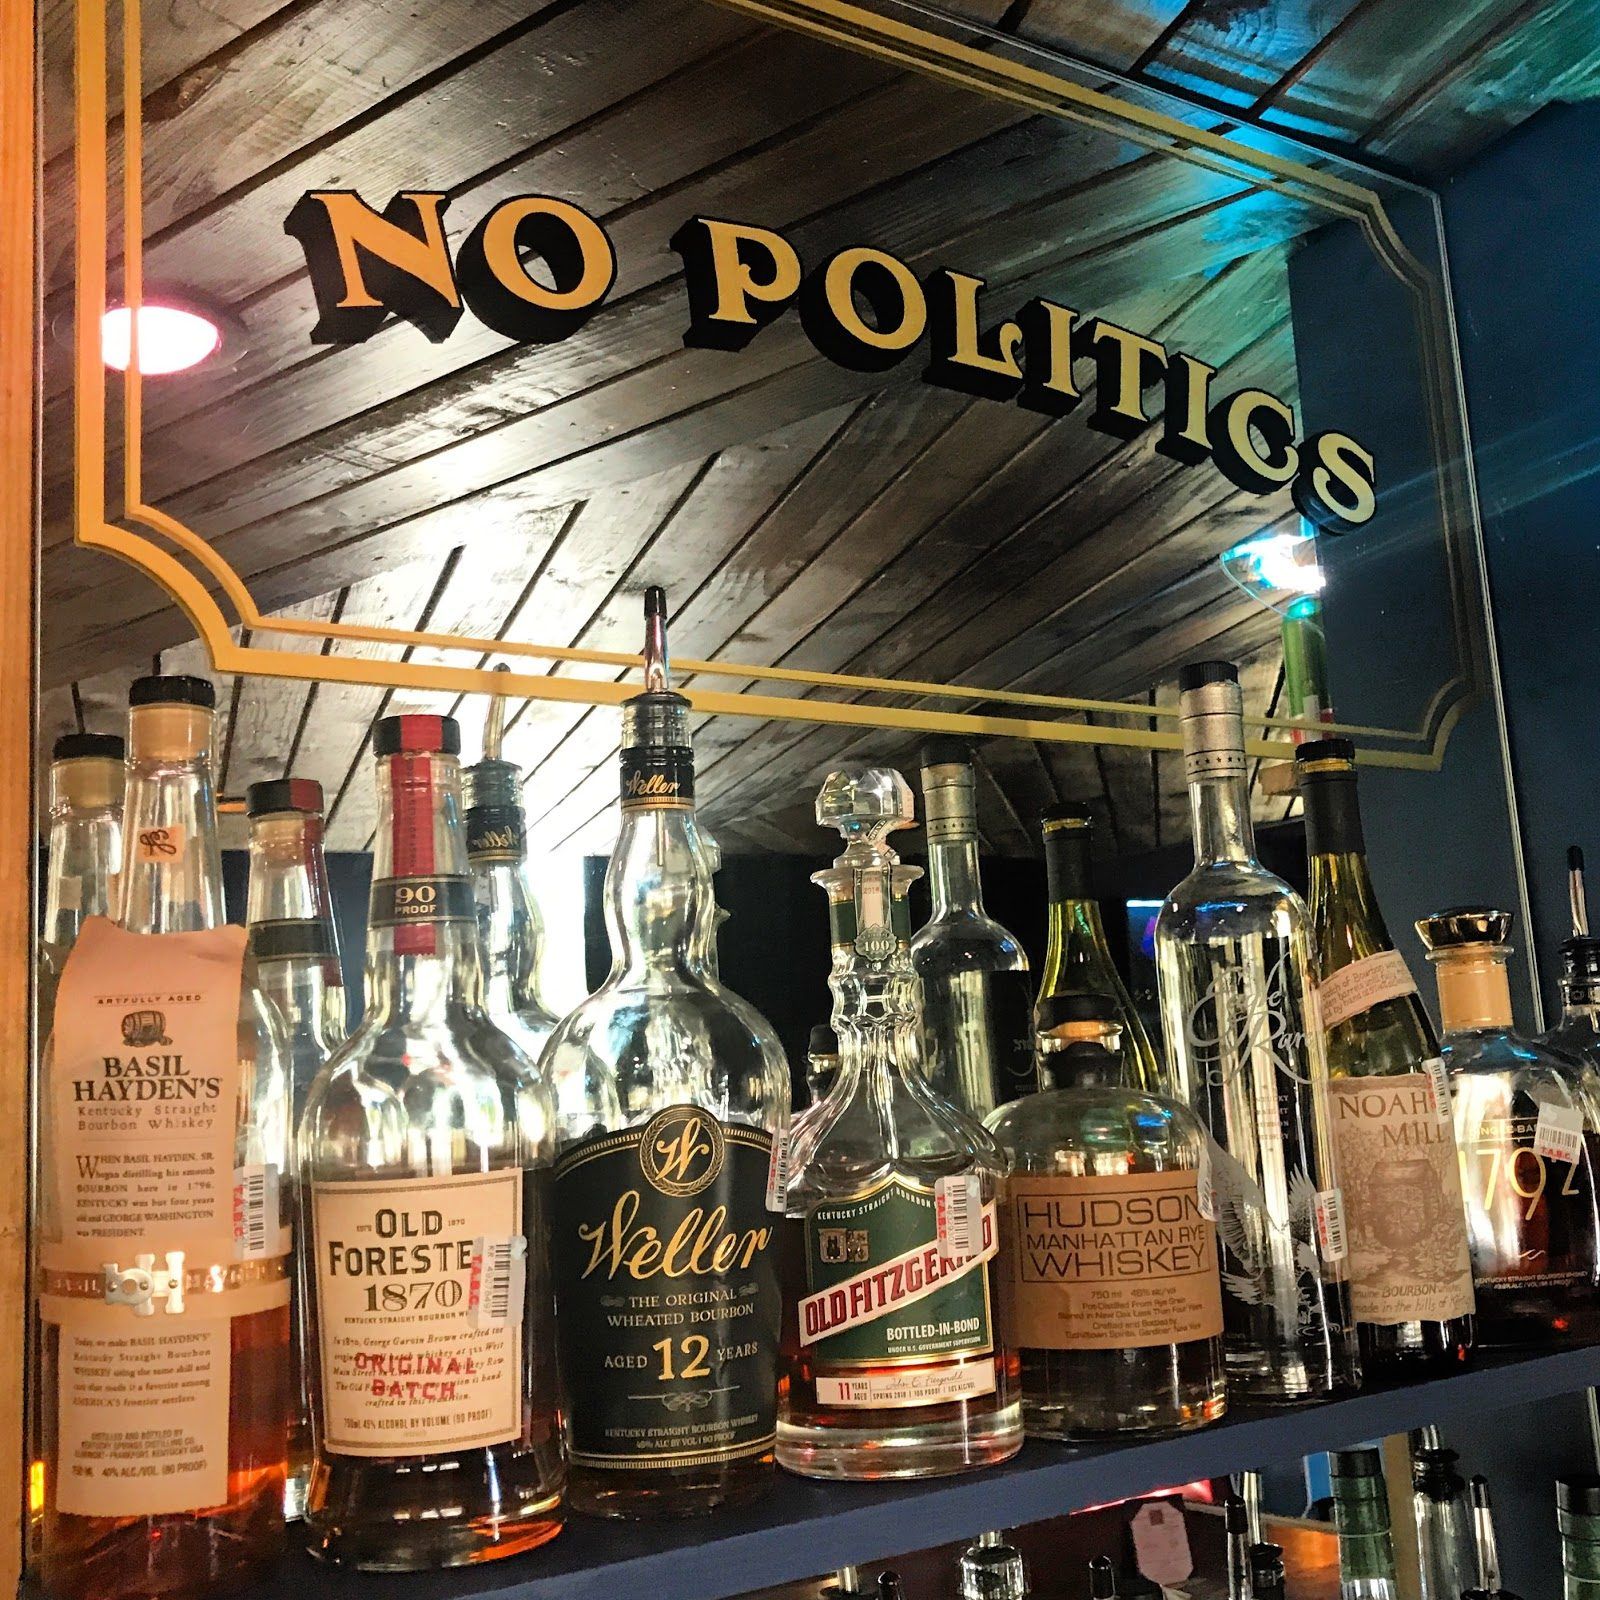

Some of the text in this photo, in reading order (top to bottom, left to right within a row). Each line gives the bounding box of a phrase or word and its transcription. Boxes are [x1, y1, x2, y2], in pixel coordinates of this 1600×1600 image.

[284, 190, 1379, 534] NO POLITICS
[626, 770, 680, 795] Weller
[394, 885, 436, 904] 90
[394, 904, 437, 914] PROOF
[864, 940, 890, 952] 100
[97, 994, 202, 1005] ARTFULLY AGED
[102, 1055, 190, 1078] BASIL
[72, 1077, 220, 1101] HAYDEN'S
[78, 1102, 216, 1117] Kentucky Straight
[78, 1117, 213, 1131] Bourbon Whiskey
[1382, 1121, 1449, 1147] MILL
[123, 1155, 149, 1164] BASIL
[1540, 1146, 1573, 1162] T.A.B.C.
[76, 1184, 128, 1193] BOURBON
[817, 1186, 932, 1220] KENTUCKY STRAIGHT BOURBON
[1024, 1195, 1203, 1228] HUDSON
[102, 1211, 214, 1223] GEORGE WASHINGTON
[375, 1208, 443, 1239] OLD
[937, 1194, 947, 1242] T.A.B.C.
[578, 1190, 774, 1281] Weller
[1026, 1224, 1205, 1250] MANHATTAN RYE
[328, 1240, 474, 1277] FORESTE
[1029, 1242, 1205, 1277] WHISKEY
[469, 1254, 482, 1310] T.A.B.C.
[1381, 1284, 1437, 1298] BOURBON
[364, 1279, 463, 1313] 1870
[628, 1288, 738, 1308] THE ORIGINAL
[344, 1316, 378, 1325] KENTUCKY
[378, 1315, 415, 1324] STRAIGHT
[418, 1313, 456, 1322] BOURBON
[607, 1302, 754, 1327] WHEATED BOURBON
[805, 1289, 848, 1337] OLD
[364, 1338, 391, 1349] George
[427, 1334, 456, 1343] Brown
[459, 1330, 490, 1340] crafted
[887, 1317, 980, 1341] BOTTLED-IN-BOND
[486, 1342, 504, 1351] West
[888, 1346, 906, 1354] UNDER
[918, 1340, 953, 1351] GOVERNMENT
[953, 1335, 981, 1346] SUPERVISION
[354, 1352, 477, 1375] ORIGINAL
[604, 1334, 758, 1380] AGED 12 YEARS
[372, 1378, 456, 1400] BATCH
[838, 1382, 868, 1401] 11 YEARS
[854, 1392, 867, 1401] AGED
[873, 1392, 893, 1400] SPRING
[378, 1418, 408, 1430] ALCOHOL
[410, 1418, 419, 1427] BY
[422, 1415, 450, 1427] VOLUME
[468, 1408, 492, 1422] PROOF)
[604, 1428, 647, 1438] KENTUCKY
[647, 1425, 691, 1437] STRAIGHT
[692, 1420, 730, 1433] BOURBON
